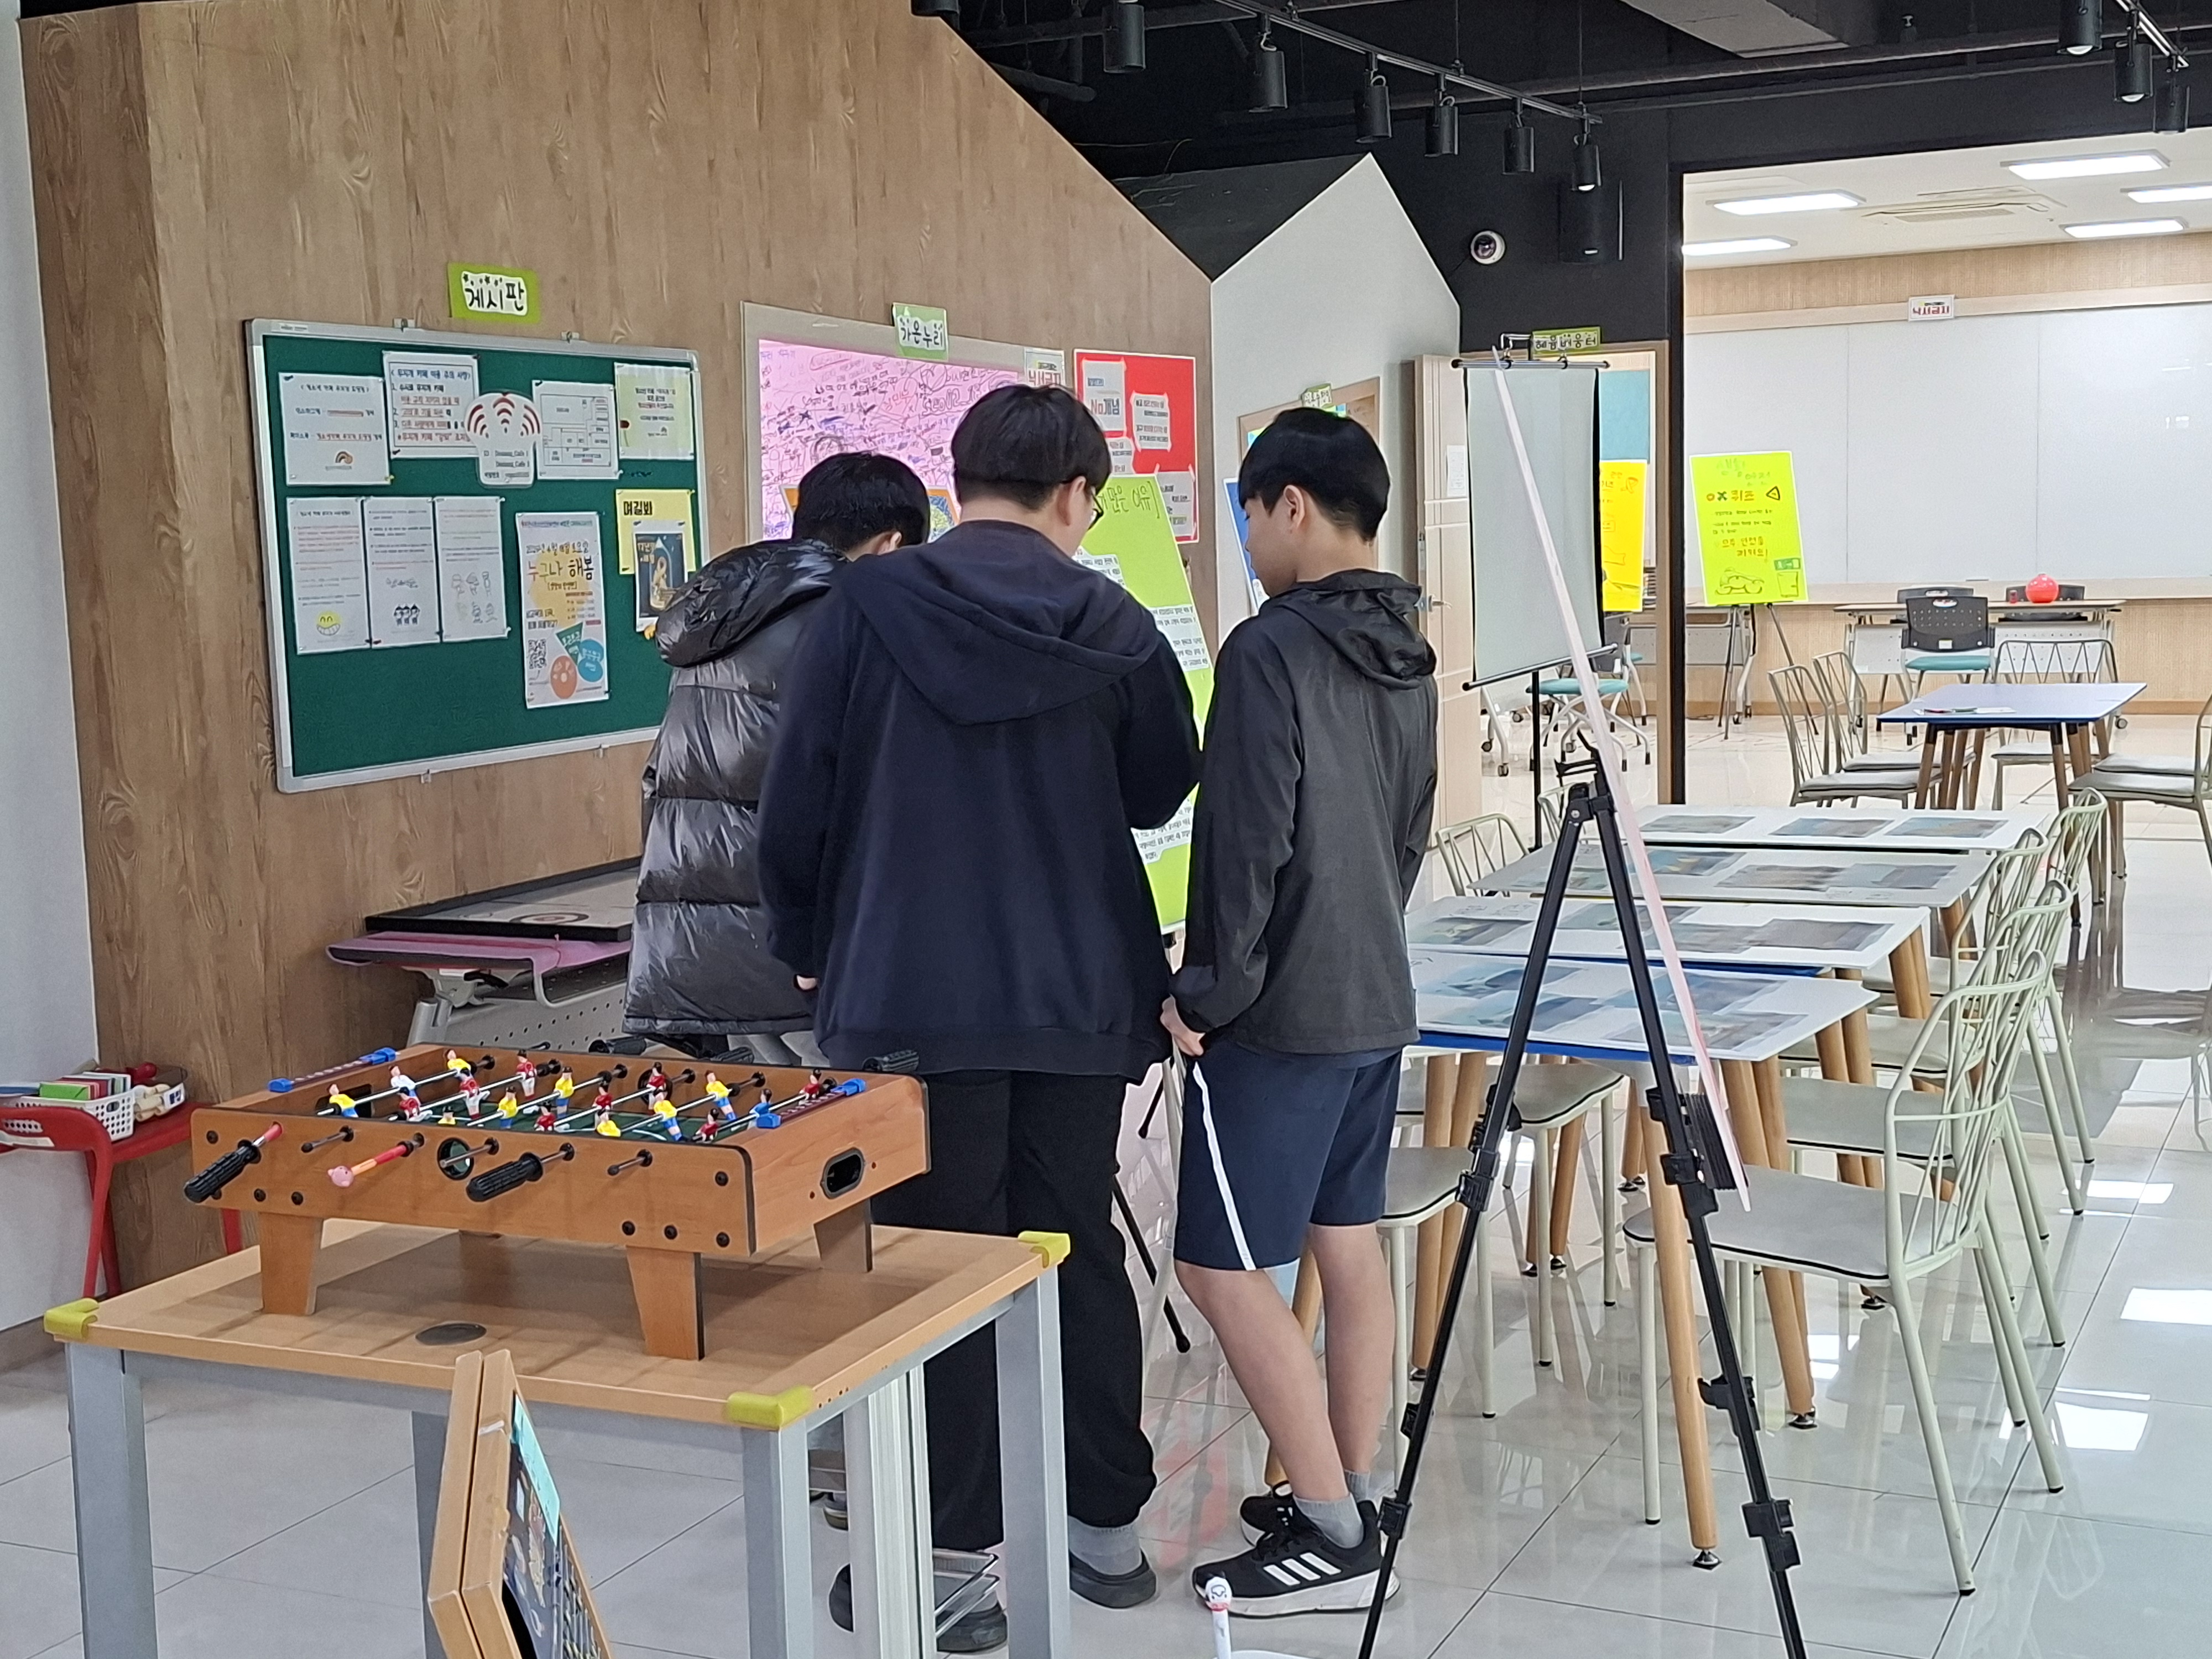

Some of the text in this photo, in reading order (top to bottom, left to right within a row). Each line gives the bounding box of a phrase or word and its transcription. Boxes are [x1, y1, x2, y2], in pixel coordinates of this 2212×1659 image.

[465, 281, 525, 311] 게시판
[900, 320, 943, 348] 가온누리
[527, 555, 594, 583] 누구나 해봄
